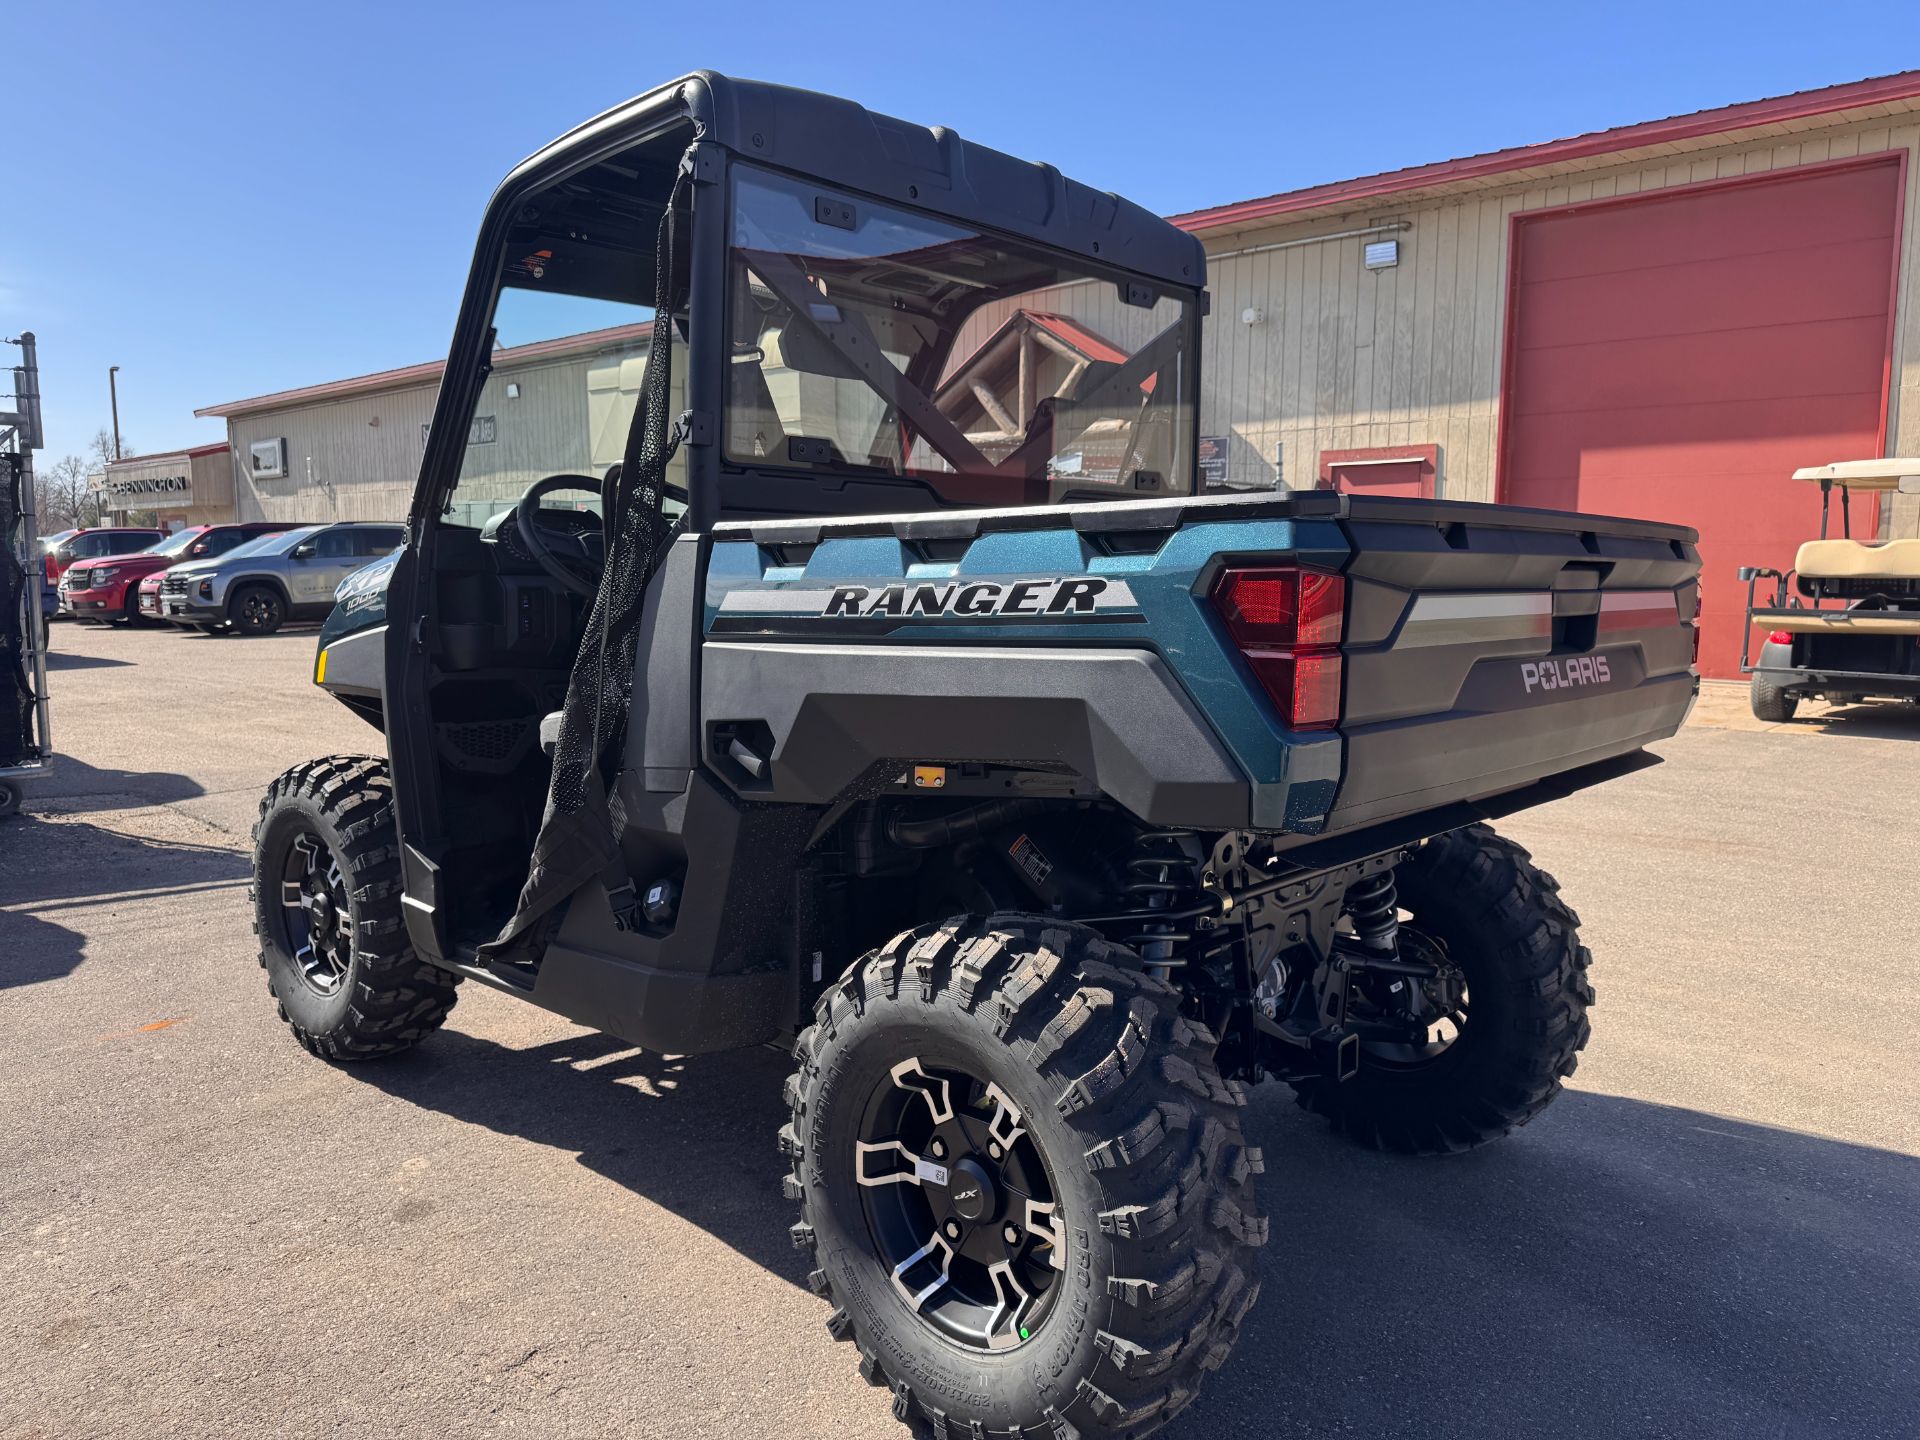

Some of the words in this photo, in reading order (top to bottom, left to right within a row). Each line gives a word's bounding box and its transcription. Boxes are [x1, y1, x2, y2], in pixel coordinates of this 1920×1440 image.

[119, 476, 185, 495] BENNINGTON
[347, 587, 381, 610] 1000
[822, 577, 1108, 616] RANGER
[1521, 656, 1611, 693] POLARIS
